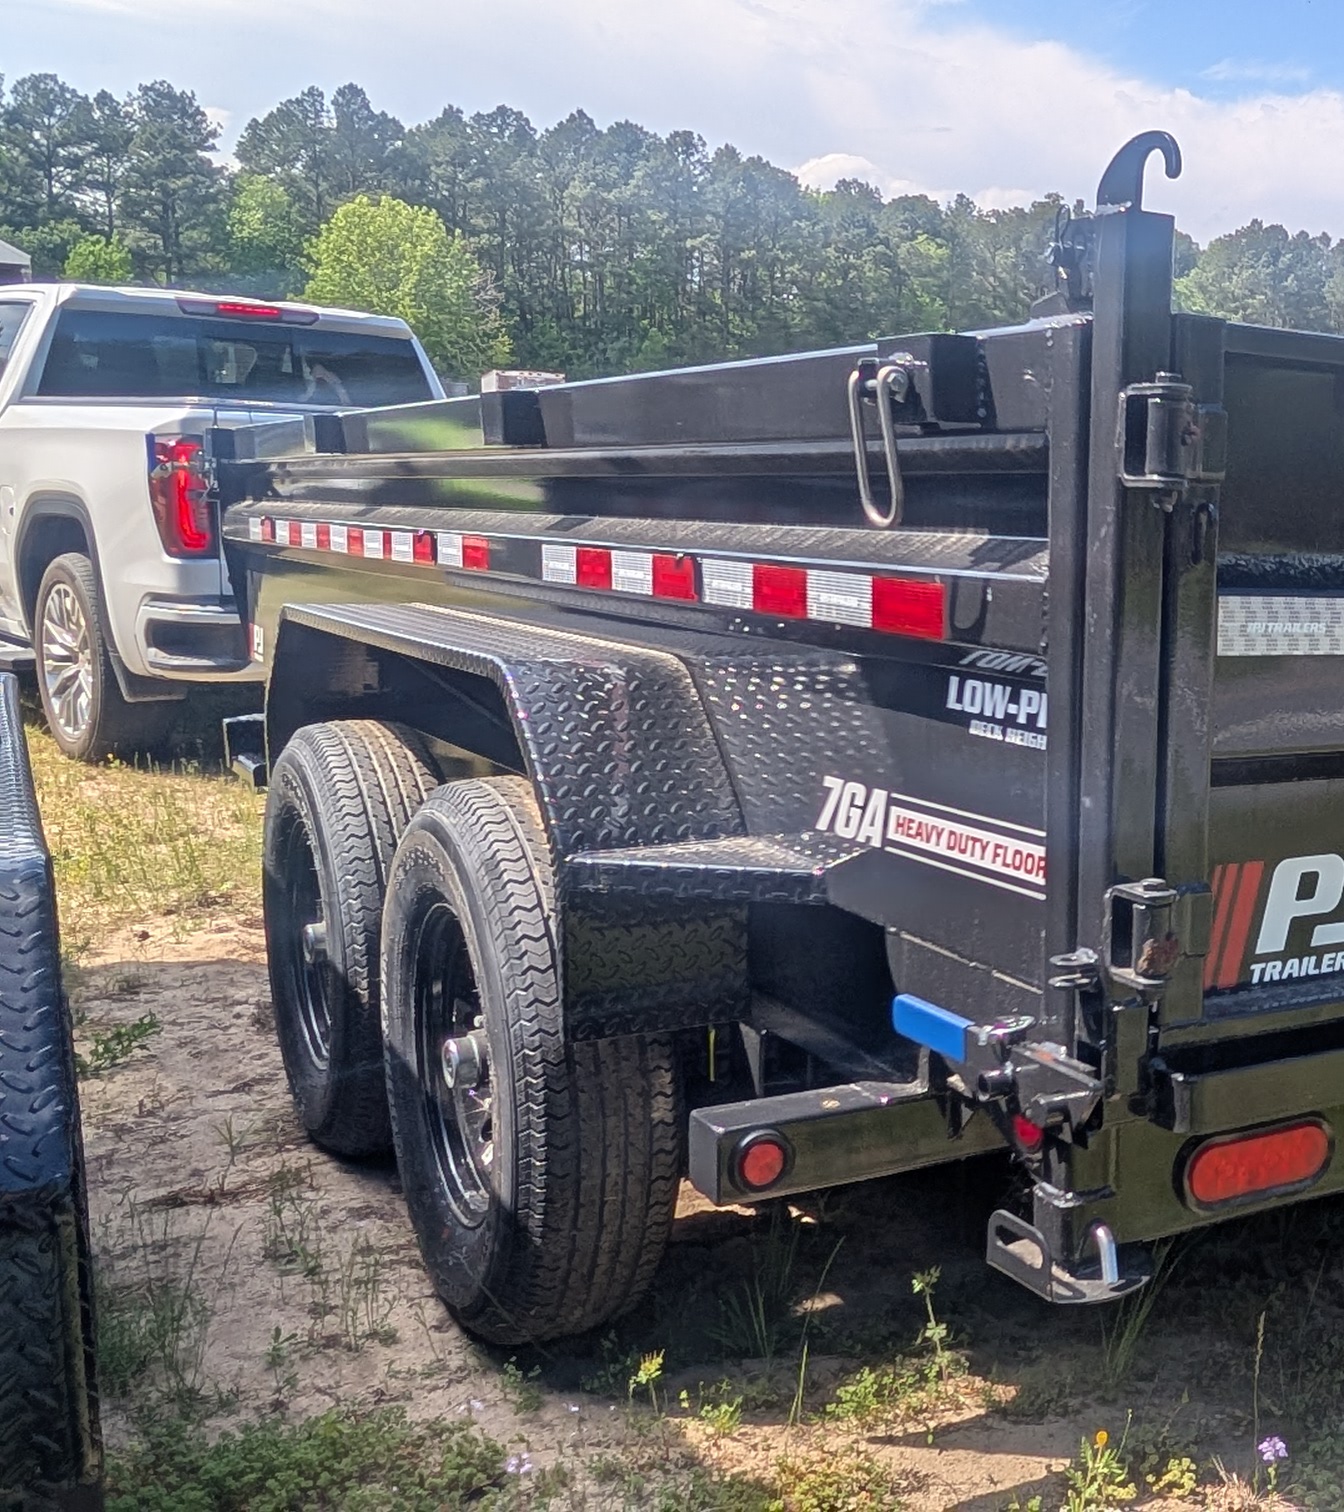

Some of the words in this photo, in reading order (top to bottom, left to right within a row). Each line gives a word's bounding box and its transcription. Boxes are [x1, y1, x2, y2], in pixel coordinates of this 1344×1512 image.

[968, 720, 1003, 741] DECK
[815, 775, 888, 848] 7GA
[895, 814, 946, 848] HEAVY
[946, 830, 992, 861] DUTY
[991, 843, 1047, 880] FLOOR
